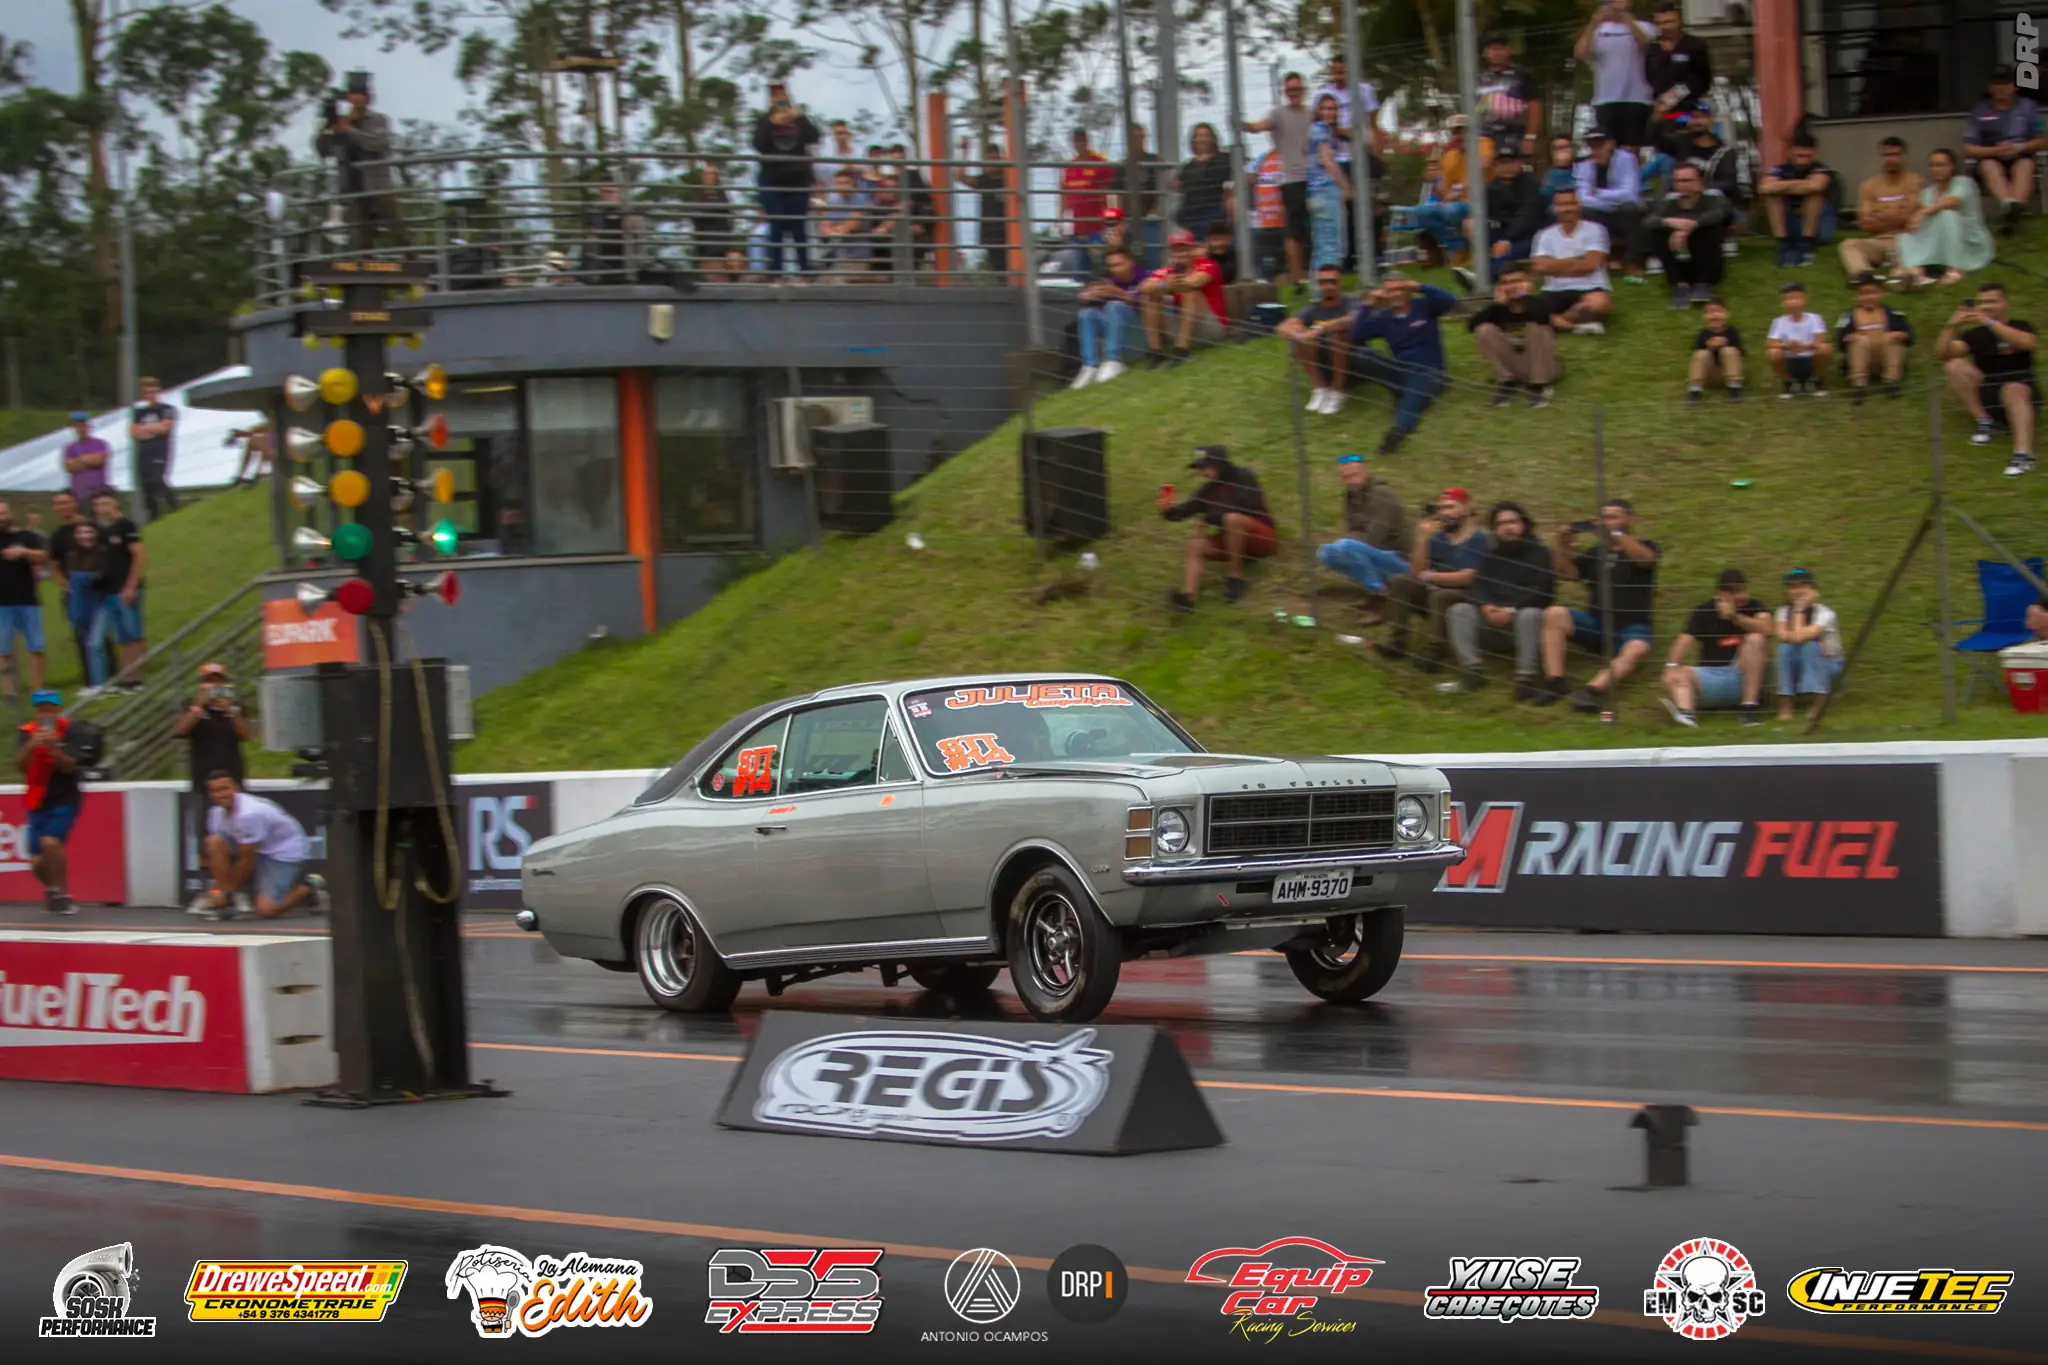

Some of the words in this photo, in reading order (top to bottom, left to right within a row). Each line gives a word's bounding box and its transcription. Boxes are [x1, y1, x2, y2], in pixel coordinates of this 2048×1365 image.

[948, 683, 1118, 708] JULIETA
[1518, 821, 1743, 877] RACING
[1743, 821, 1899, 878] FUEL
[0, 971, 205, 1038] uelTech
[815, 1050, 1050, 1113] REGIS
